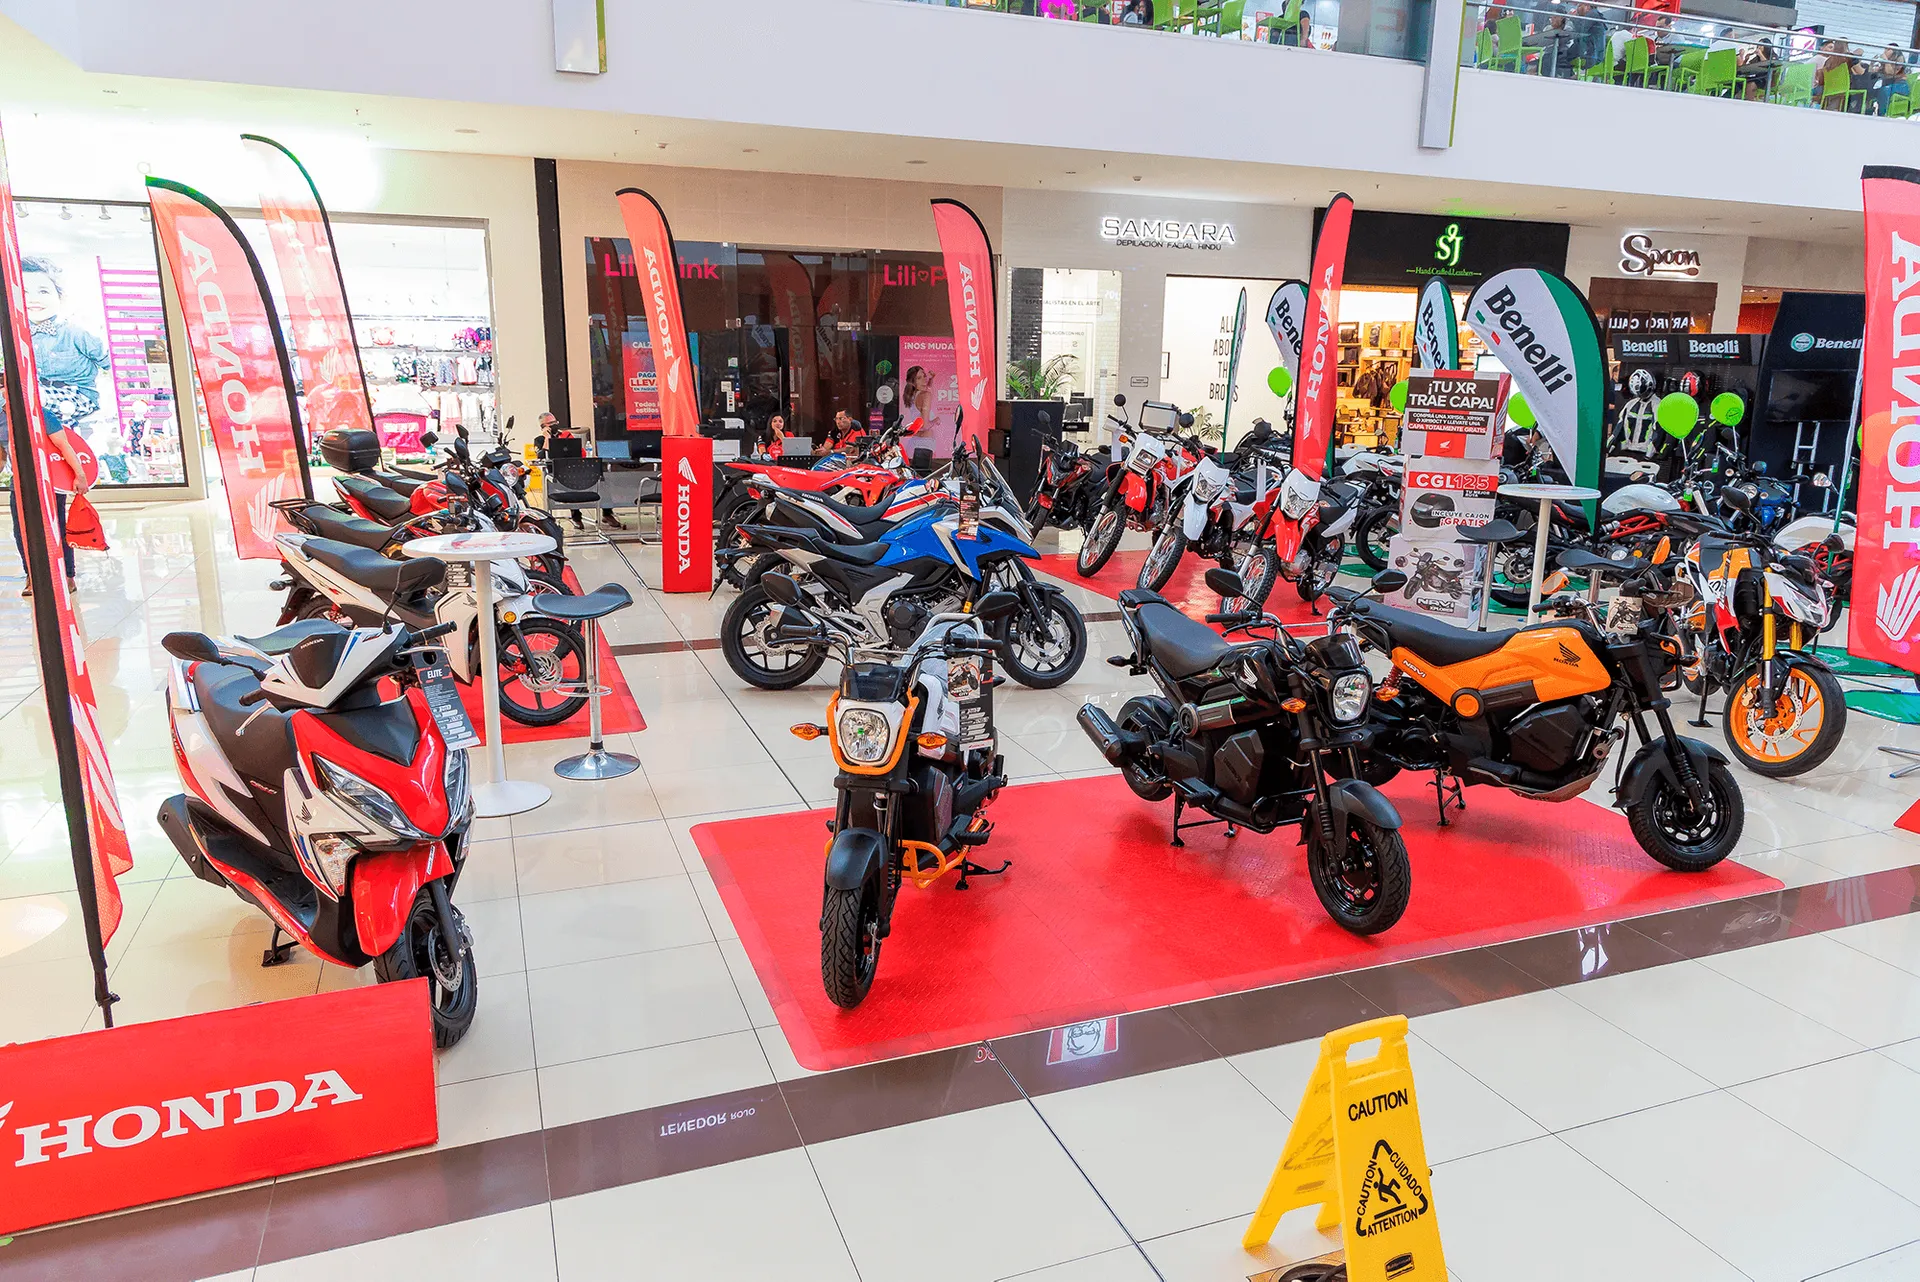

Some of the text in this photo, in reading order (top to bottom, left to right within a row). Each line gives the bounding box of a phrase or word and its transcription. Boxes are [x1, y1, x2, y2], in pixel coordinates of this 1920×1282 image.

[1102, 217, 1235, 242] SAMSARA
[1167, 242, 1194, 250] FACIAL
[1620, 233, 1701, 276] Spoon
[604, 253, 719, 279] Lil ink
[883, 264, 917, 287] Lili
[1219, 316, 1235, 334] ALL
[1275, 296, 1302, 360] Bene
[1306, 263, 1334, 402] HONDA
[1421, 300, 1447, 370] Benel
[1484, 284, 1573, 395] Benelli
[1814, 337, 1863, 349] Benell
[1212, 338, 1232, 356] ABO
[1621, 339, 1668, 353] Benelli
[1688, 339, 1740, 354] Benelli
[1218, 361, 1230, 379] TH
[937, 389, 960, 402] PIS
[1209, 382, 1239, 402] BROS
[1428, 380, 1477, 395] ¡TU XR
[1408, 393, 1495, 410] TRAE CAPA!
[1425, 424, 1463, 432] TOTALMENTE
[1416, 473, 1490, 491] CGL125
[1431, 510, 1462, 518] INCLUYE
[677, 483, 691, 574] HONDA
[300, 638, 324, 649] HONDA
[1402, 659, 1427, 679] NAVI
[1553, 657, 1579, 668] HONDA
[427, 668, 443, 679] ELITE
[1348, 1088, 1409, 1122] CAUTION
[14, 1069, 363, 1168] HONDA
[1388, 1151, 1423, 1198] CUIDADO
[1356, 1159, 1378, 1217] CAUTION
[1367, 1207, 1419, 1238] ATTENTION
